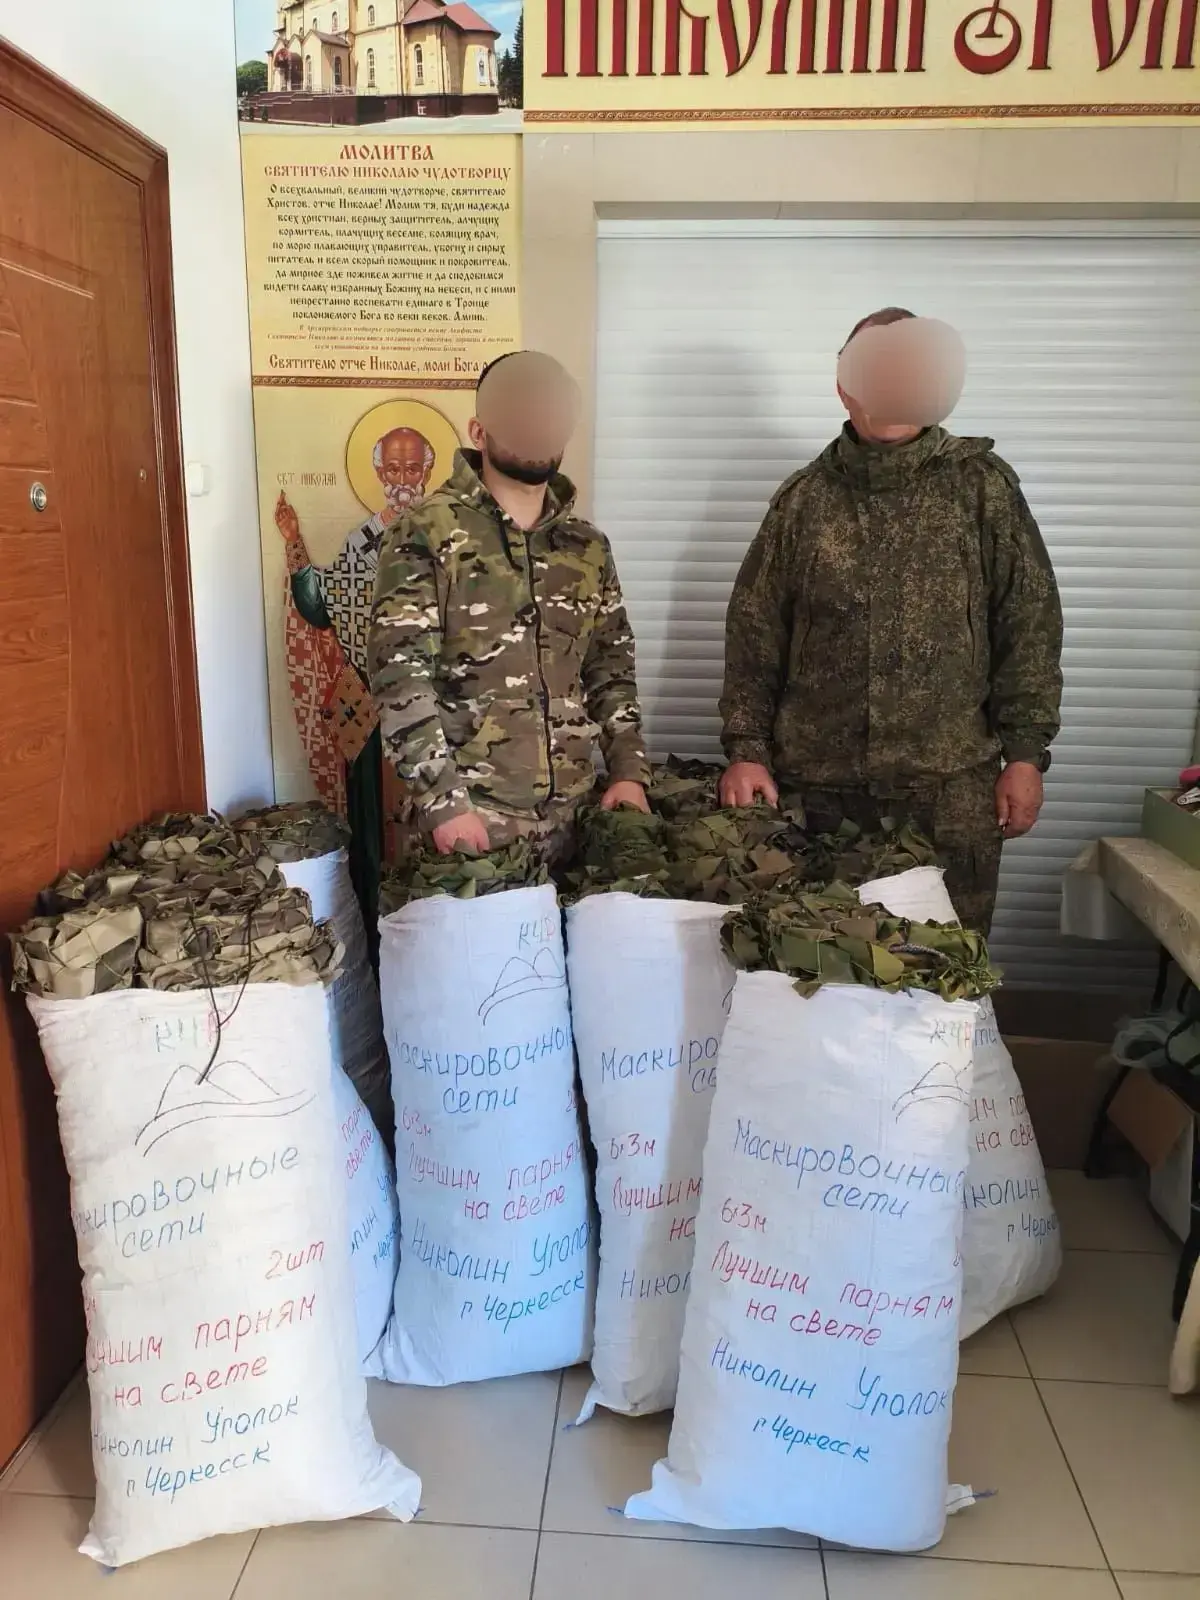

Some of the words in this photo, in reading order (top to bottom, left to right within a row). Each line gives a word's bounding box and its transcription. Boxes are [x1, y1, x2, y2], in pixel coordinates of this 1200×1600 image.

[340, 144, 434, 160] МОЛИТВА
[264, 165, 349, 177] СВЯТИТЕЛЮ
[352, 166, 419, 178] НИКОЛАЮ
[423, 167, 511, 181] ЧУДОТВОРЦУ
[270, 184, 277, 194] О
[451, 188, 506, 196] святителю
[313, 200, 336, 208] отче
[385, 199, 420, 209] Молим
[467, 202, 510, 212] надежда
[278, 214, 299, 224] всех
[351, 215, 386, 226] верных
[272, 242, 283, 250] по
[286, 243, 311, 252] морю
[326, 257, 349, 265] всем
[275, 270, 287, 279] да
[289, 270, 324, 280] мирное
[327, 271, 344, 279] зде
[434, 273, 446, 281] да
[301, 284, 328, 294] славу
[292, 311, 356, 320] поклоняемого
[360, 309, 381, 321] Бога
[397, 313, 419, 321] веки
[268, 354, 336, 369] Святителю
[339, 359, 366, 371] отче
[369, 356, 420, 373] Николае,
[422, 360, 450, 372] моли
[454, 357, 479, 372] Бога
[601, 1037, 718, 1084] Маскиро
[443, 1086, 518, 1114] сети
[975, 1131, 1001, 1153] на
[464, 1198, 490, 1221] на
[822, 1183, 909, 1220] сети
[121, 1212, 206, 1258] сети
[264, 1240, 326, 1281] 2шт
[412, 1218, 510, 1285] Николин
[711, 1240, 811, 1297] Лучшим
[840, 1282, 955, 1326] парням
[484, 1270, 585, 1335] Черкесск
[745, 1298, 777, 1324] на
[194, 1293, 317, 1353] парням
[711, 1337, 817, 1401] Николин
[115, 1384, 143, 1409] на
[200, 1395, 300, 1444] Уголок
[770, 1414, 872, 1463] Черкесск
[144, 1440, 272, 1505] Черкесск
